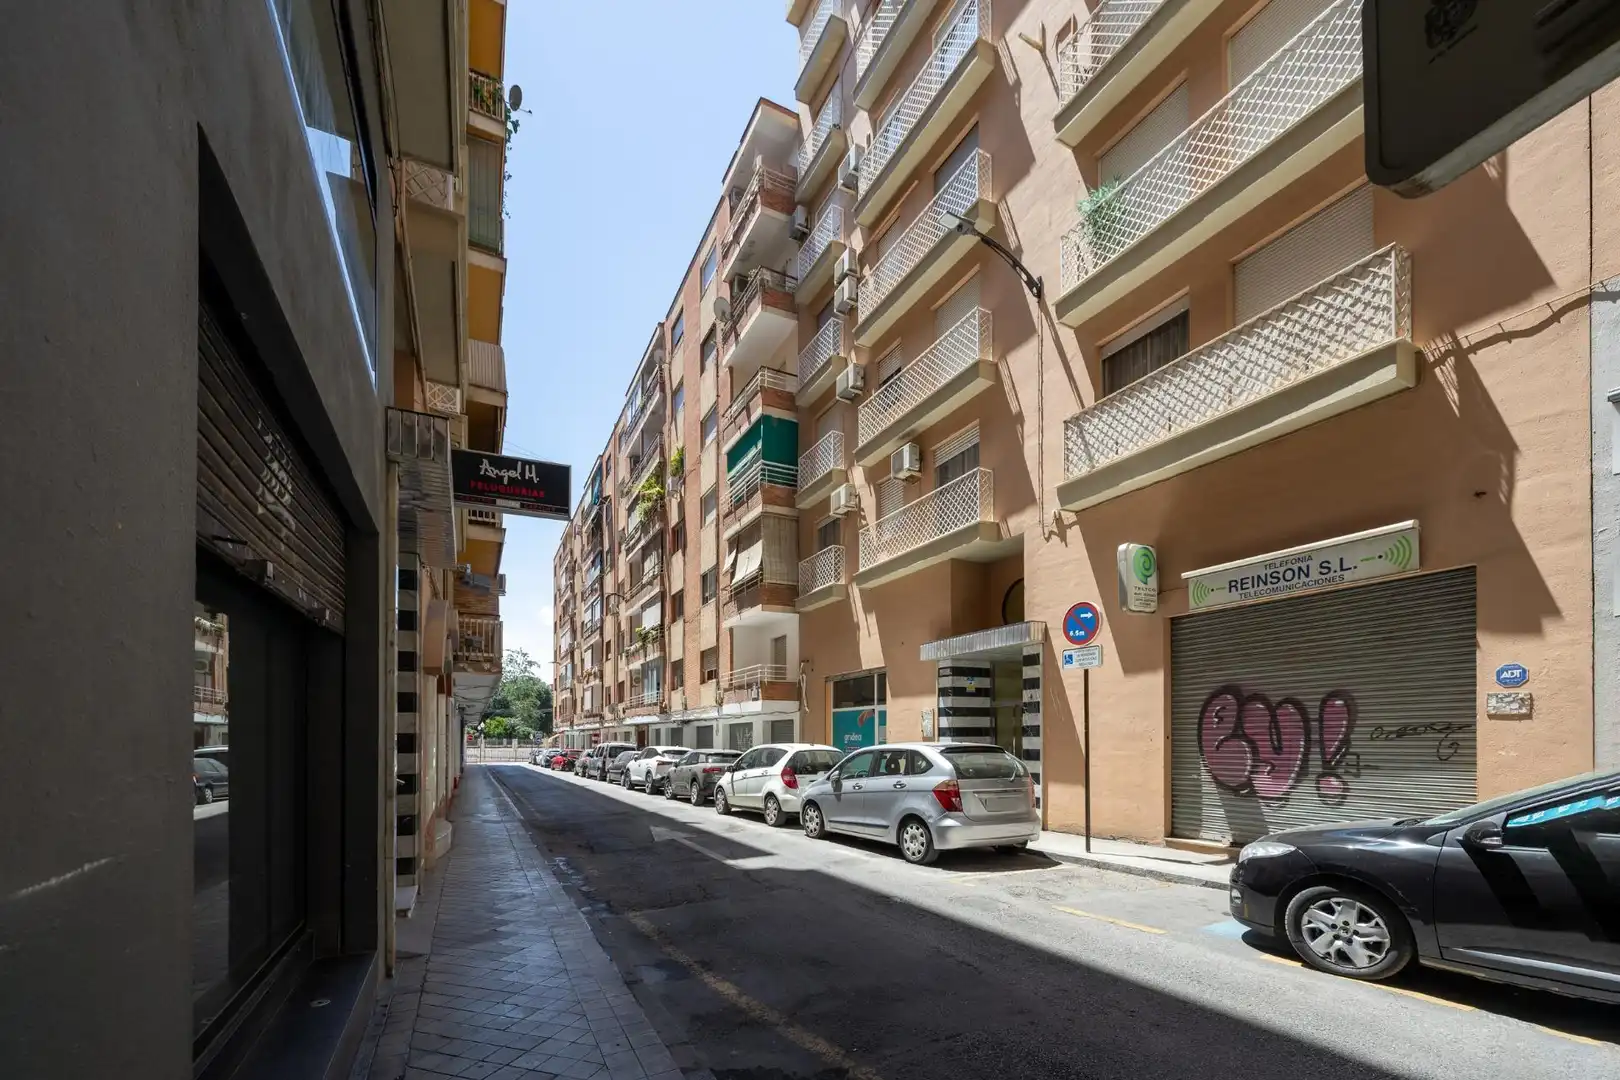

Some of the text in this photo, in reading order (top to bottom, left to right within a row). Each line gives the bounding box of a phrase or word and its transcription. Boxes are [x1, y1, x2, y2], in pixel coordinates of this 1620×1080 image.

[470, 480, 545, 497] PELUQUERIAS
[1264, 555, 1313, 570] TELEFONIA
[1228, 557, 1358, 593] REINSON S.L.
[1239, 574, 1345, 600] TELECOMUNICACIONES
[1500, 669, 1522, 680] ADT
